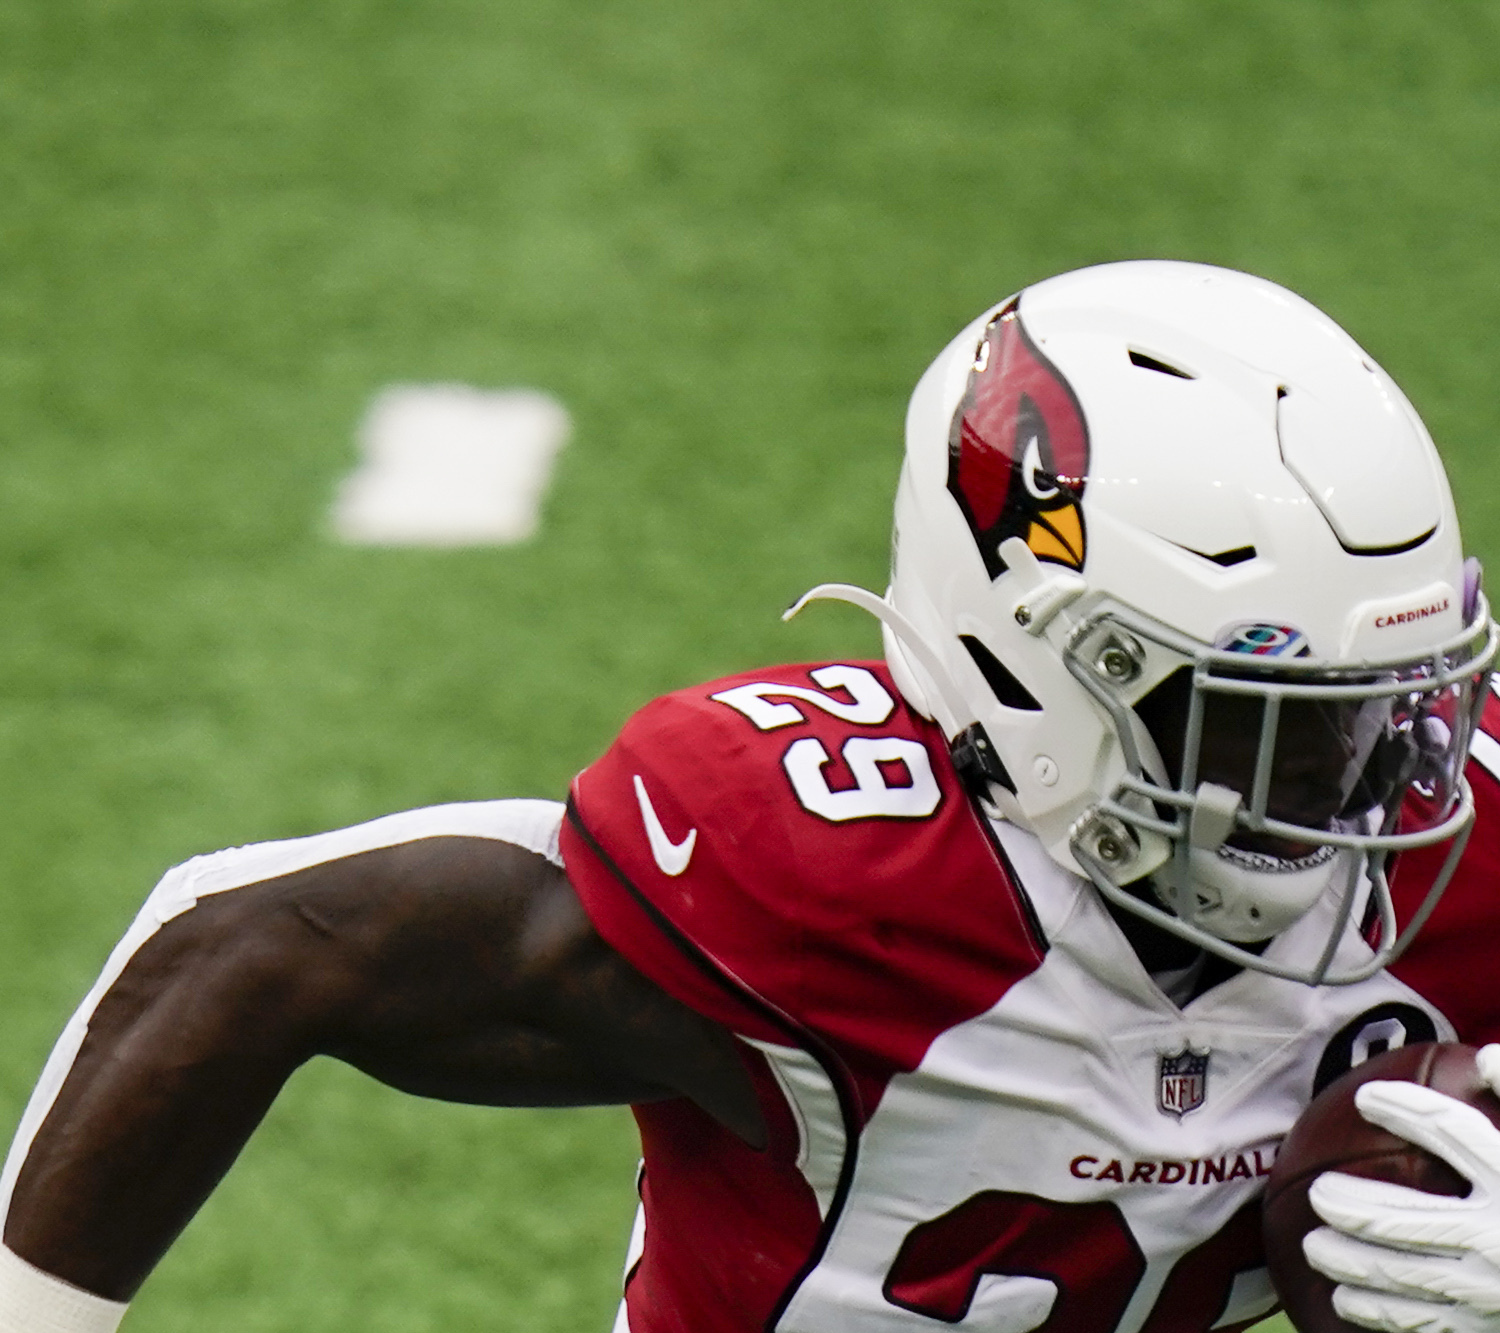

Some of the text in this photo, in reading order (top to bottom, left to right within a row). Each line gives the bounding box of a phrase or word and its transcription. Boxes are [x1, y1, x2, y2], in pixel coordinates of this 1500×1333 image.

[710, 664, 942, 822] 29
[1164, 1078, 1201, 1109] NFL
[1069, 1145, 1280, 1186] CARDINAL
